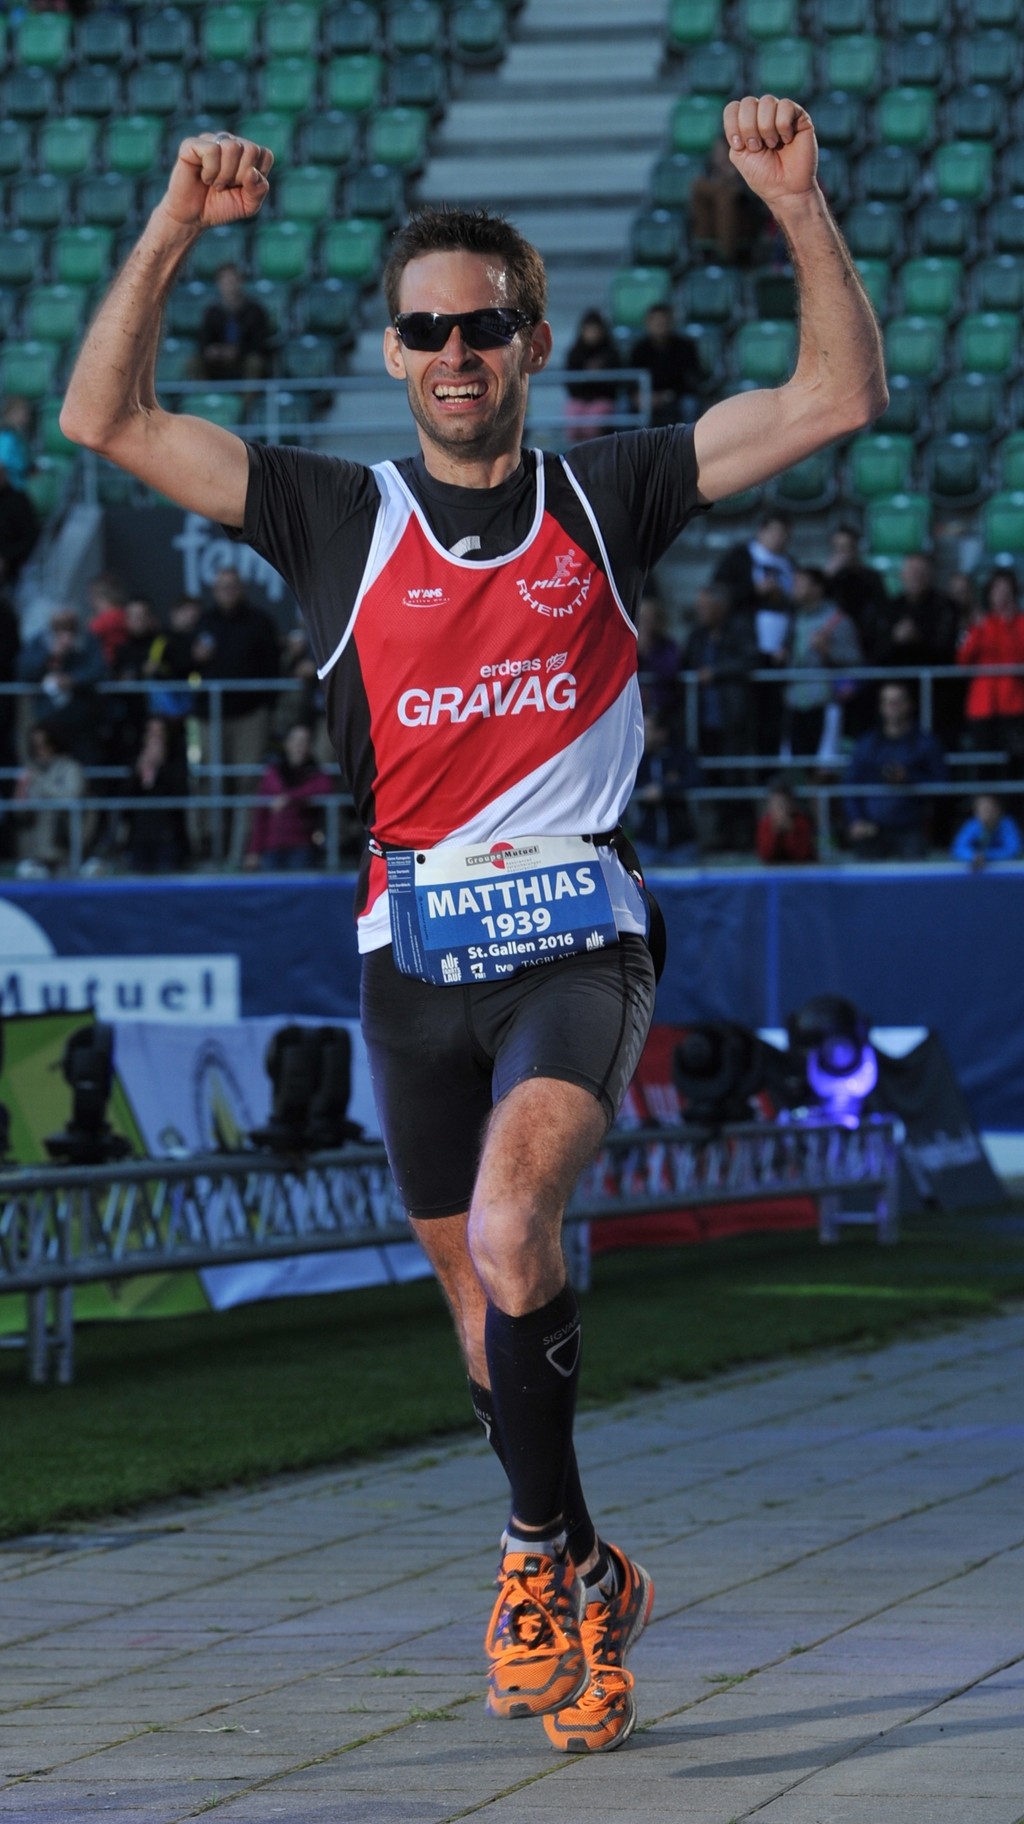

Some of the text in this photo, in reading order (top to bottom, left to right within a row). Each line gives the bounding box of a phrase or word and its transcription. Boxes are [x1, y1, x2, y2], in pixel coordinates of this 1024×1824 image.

[516, 572, 591, 618] RHEINTAL
[480, 657, 541, 678] erdgas
[397, 672, 576, 727] GRAVAG
[467, 846, 538, 865] Groupe Mutuel
[426, 867, 596, 919] MATTHIAS
[481, 907, 552, 939] 1939
[467, 932, 575, 960] St. Gallen 2016
